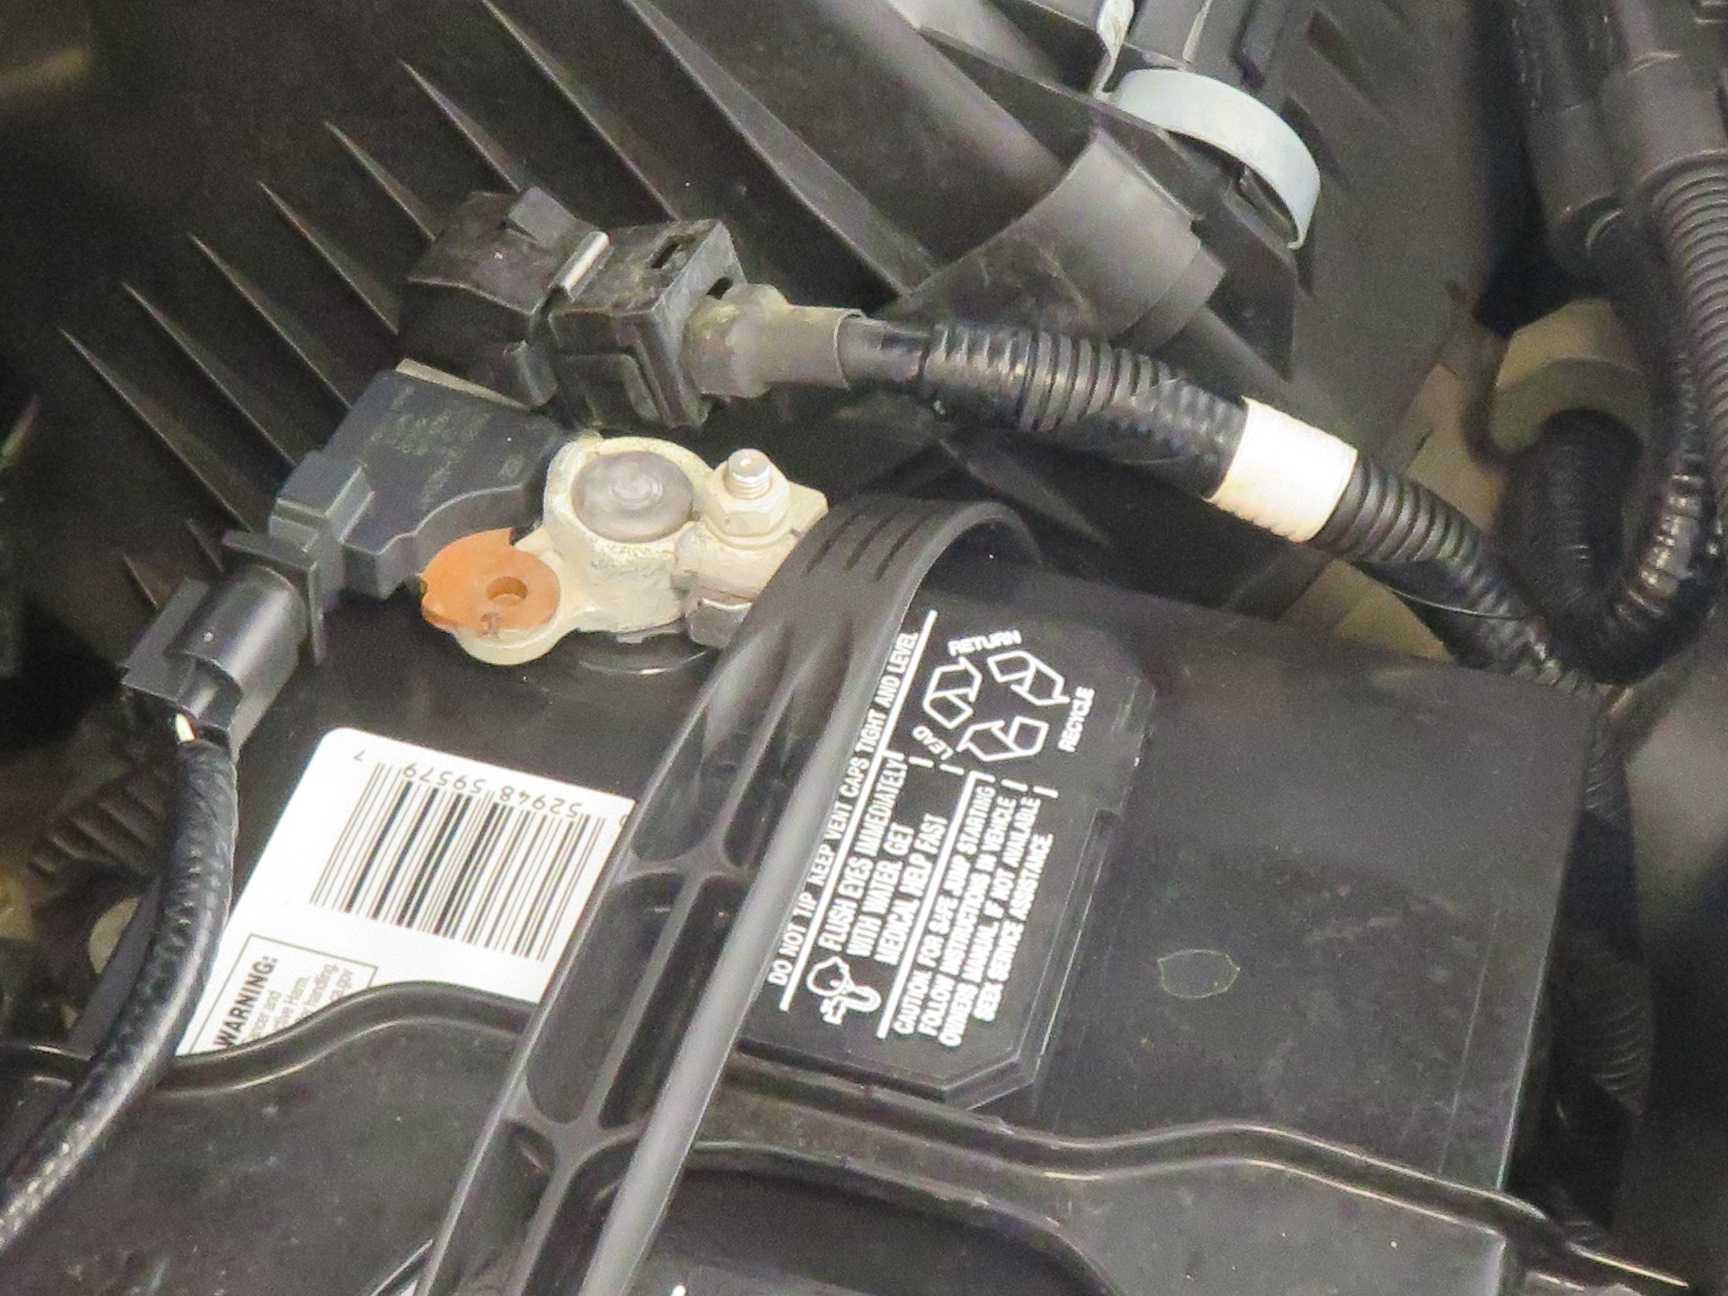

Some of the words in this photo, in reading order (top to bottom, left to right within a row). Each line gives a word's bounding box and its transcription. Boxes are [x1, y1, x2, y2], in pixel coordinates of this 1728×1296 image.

[887, 633, 919, 674] LEVEL
[947, 629, 1022, 656] RETURN
[874, 674, 899, 709] AND
[855, 709, 887, 758] TIGHT
[1057, 686, 1095, 753] RECYCLE
[352, 749, 366, 762] 7
[912, 724, 954, 759] LEAD
[403, 762, 484, 794] 59579
[840, 757, 869, 797] CAPS
[500, 785, 582, 818] 52948
[824, 800, 852, 840] VENT
[858, 756, 908, 857] IMMEDIATELY
[956, 786, 996, 855] STARTING
[914, 813, 948, 855] FAST
[980, 795, 1017, 852] VEHICLE
[1002, 796, 1041, 868] AVAILABLE
[806, 843, 836, 887] KEEP
[837, 856, 874, 899] EYES
[898, 852, 933, 897] HELP
[942, 854, 971, 897] JUMP
[974, 853, 997, 872] IN
[1008, 833, 1054, 921] ASSISTANCE.
[846, 914, 883, 957] WITH
[884, 822, 915, 856] GET
[989, 867, 1016, 901] NOT
[793, 891, 820, 923] TIP
[817, 898, 858, 952] FLUSH
[928, 894, 959, 935] SAFE
[939, 872, 992, 976] INSTRUCTIONS
[983, 899, 1005, 919] IF
[780, 922, 810, 958] NOT
[874, 899, 921, 965] MEDICAL
[916, 934, 945, 968] FOR
[986, 919, 1025, 982] SERVICE
[769, 960, 793, 986] DO
[217, 955, 279, 1047] WARNING:
[918, 973, 956, 1040] FOLLOW
[973, 981, 1004, 1022] SEEK
